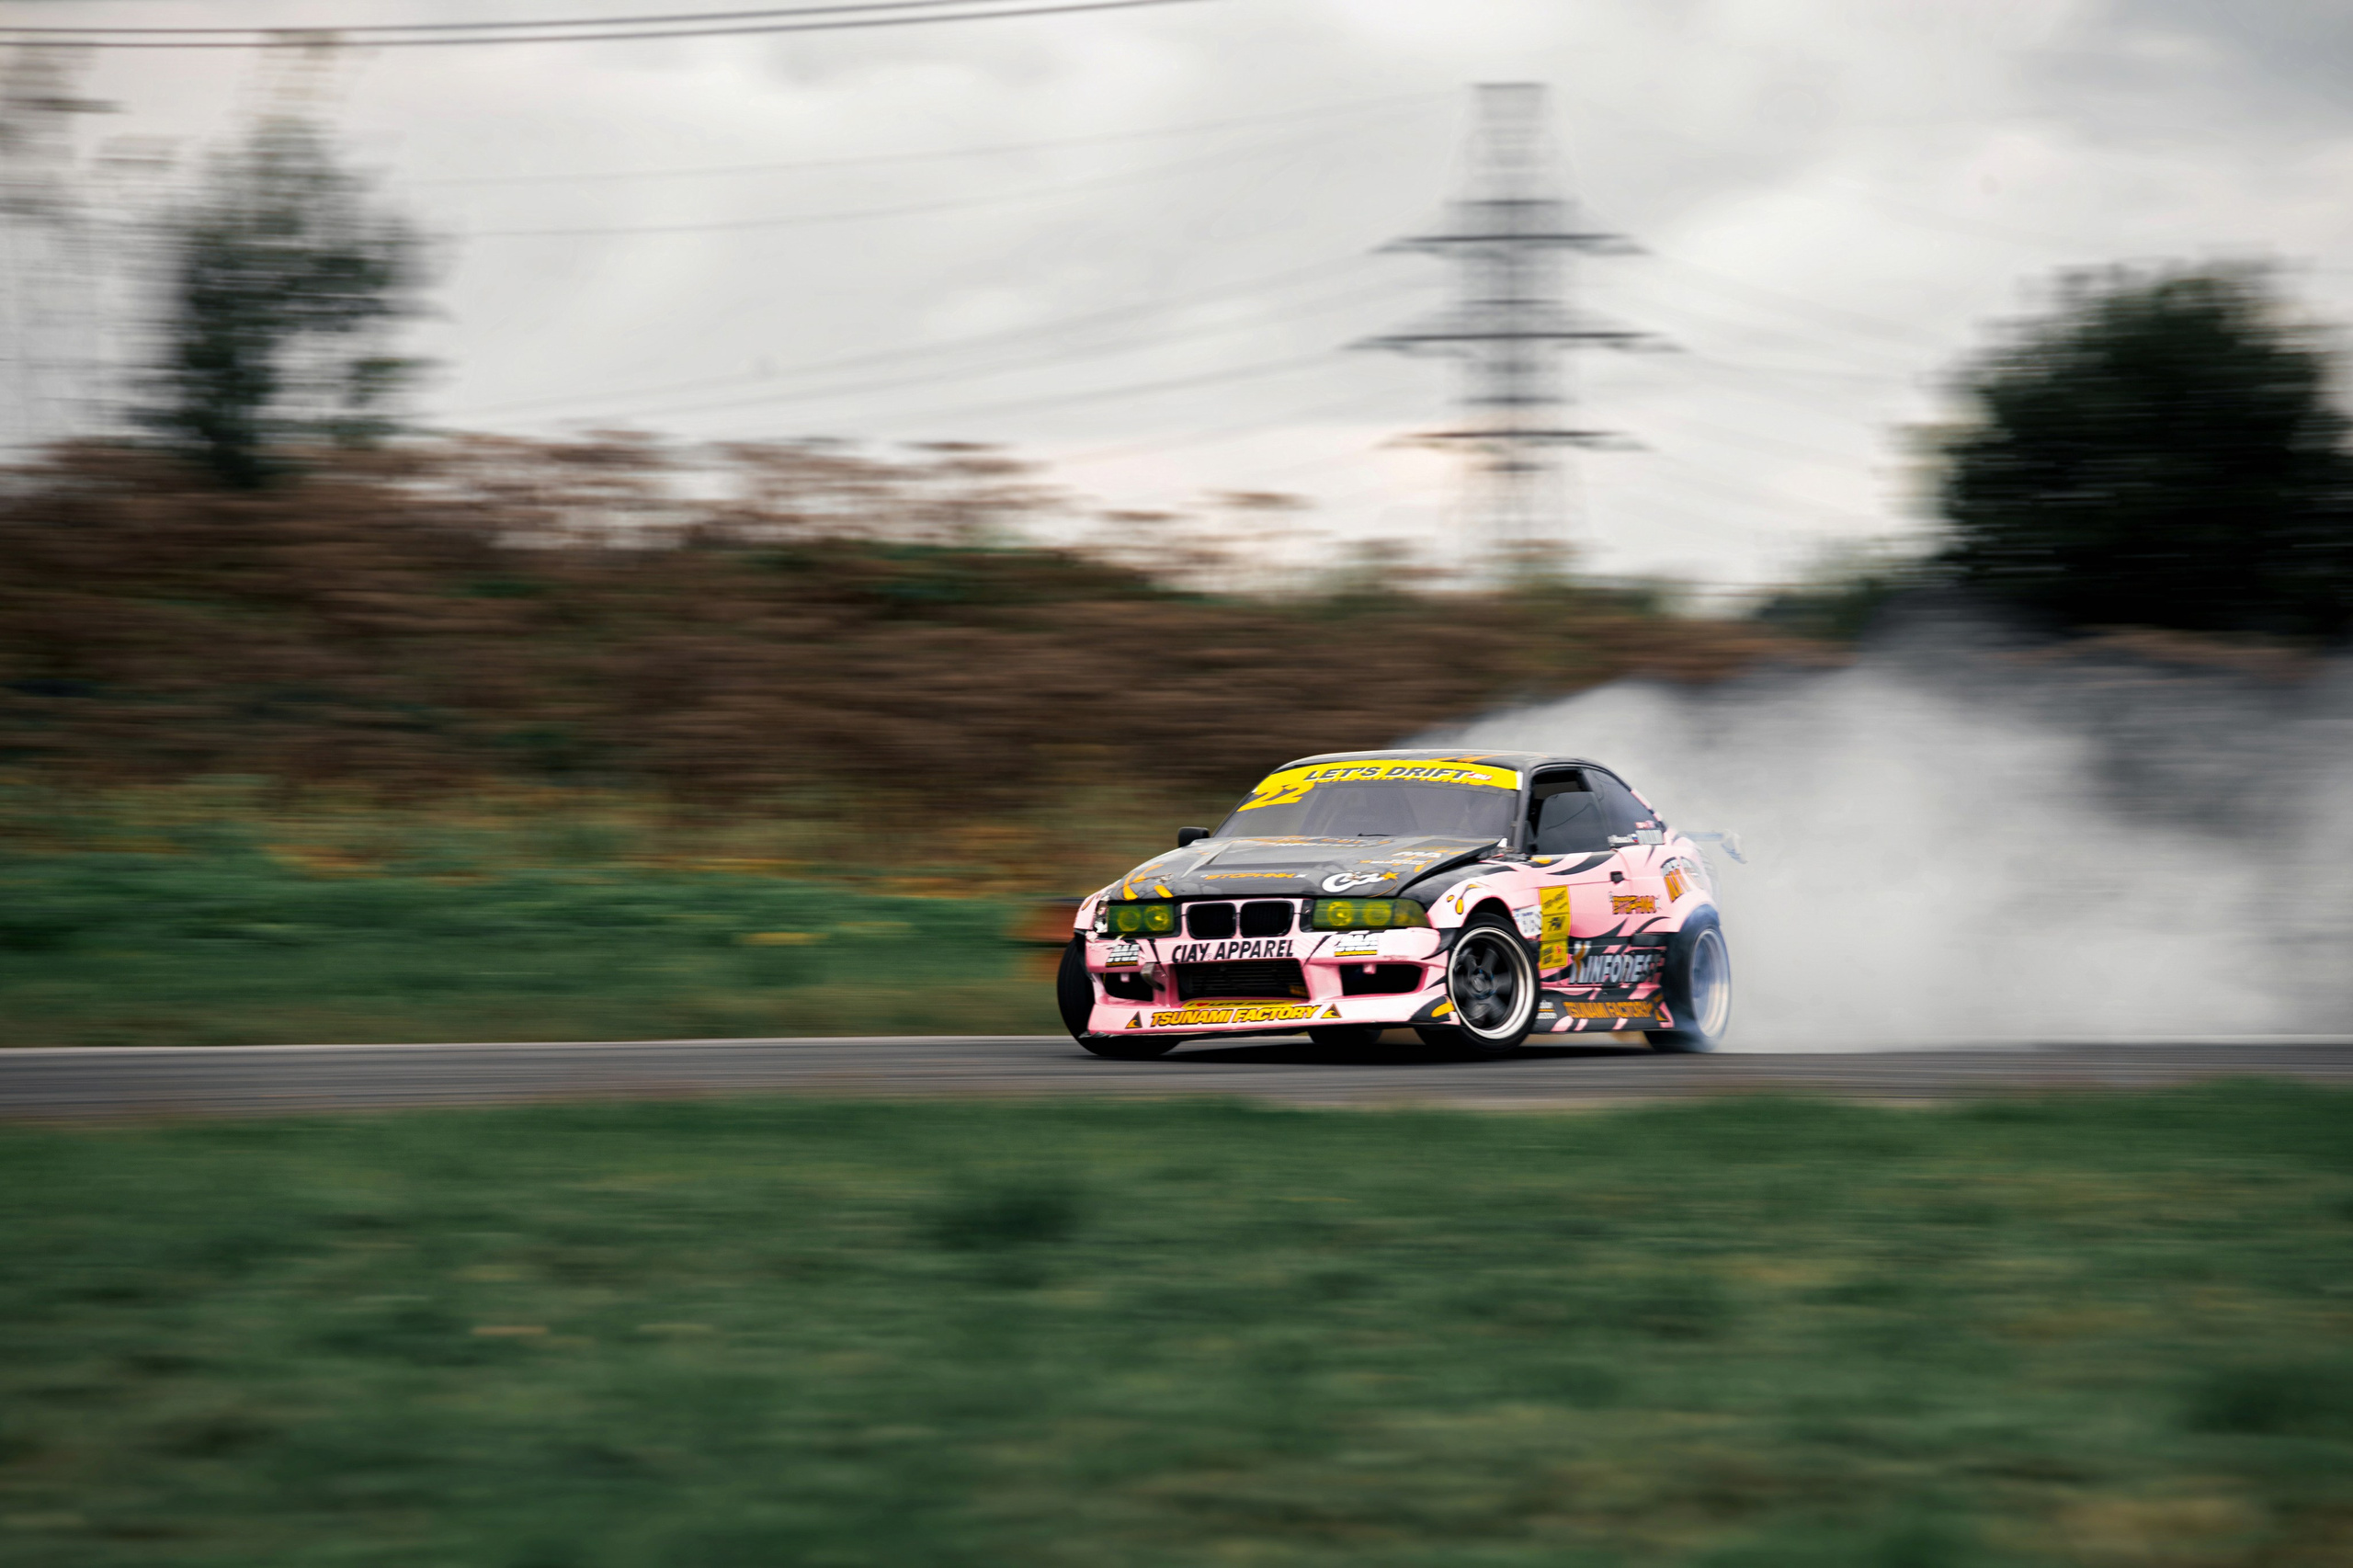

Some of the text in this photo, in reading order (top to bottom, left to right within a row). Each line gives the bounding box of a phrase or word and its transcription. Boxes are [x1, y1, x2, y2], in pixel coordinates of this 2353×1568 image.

[1303, 767, 1383, 781] LET'S
[1236, 781, 1314, 812] 22
[1214, 939, 1294, 960] APPAREL
[1150, 1005, 1322, 1028] TSUNAMI FACTORY
[1563, 1001, 1611, 1018] TSUNAMI
[1605, 1001, 1654, 1018] FACTORY
